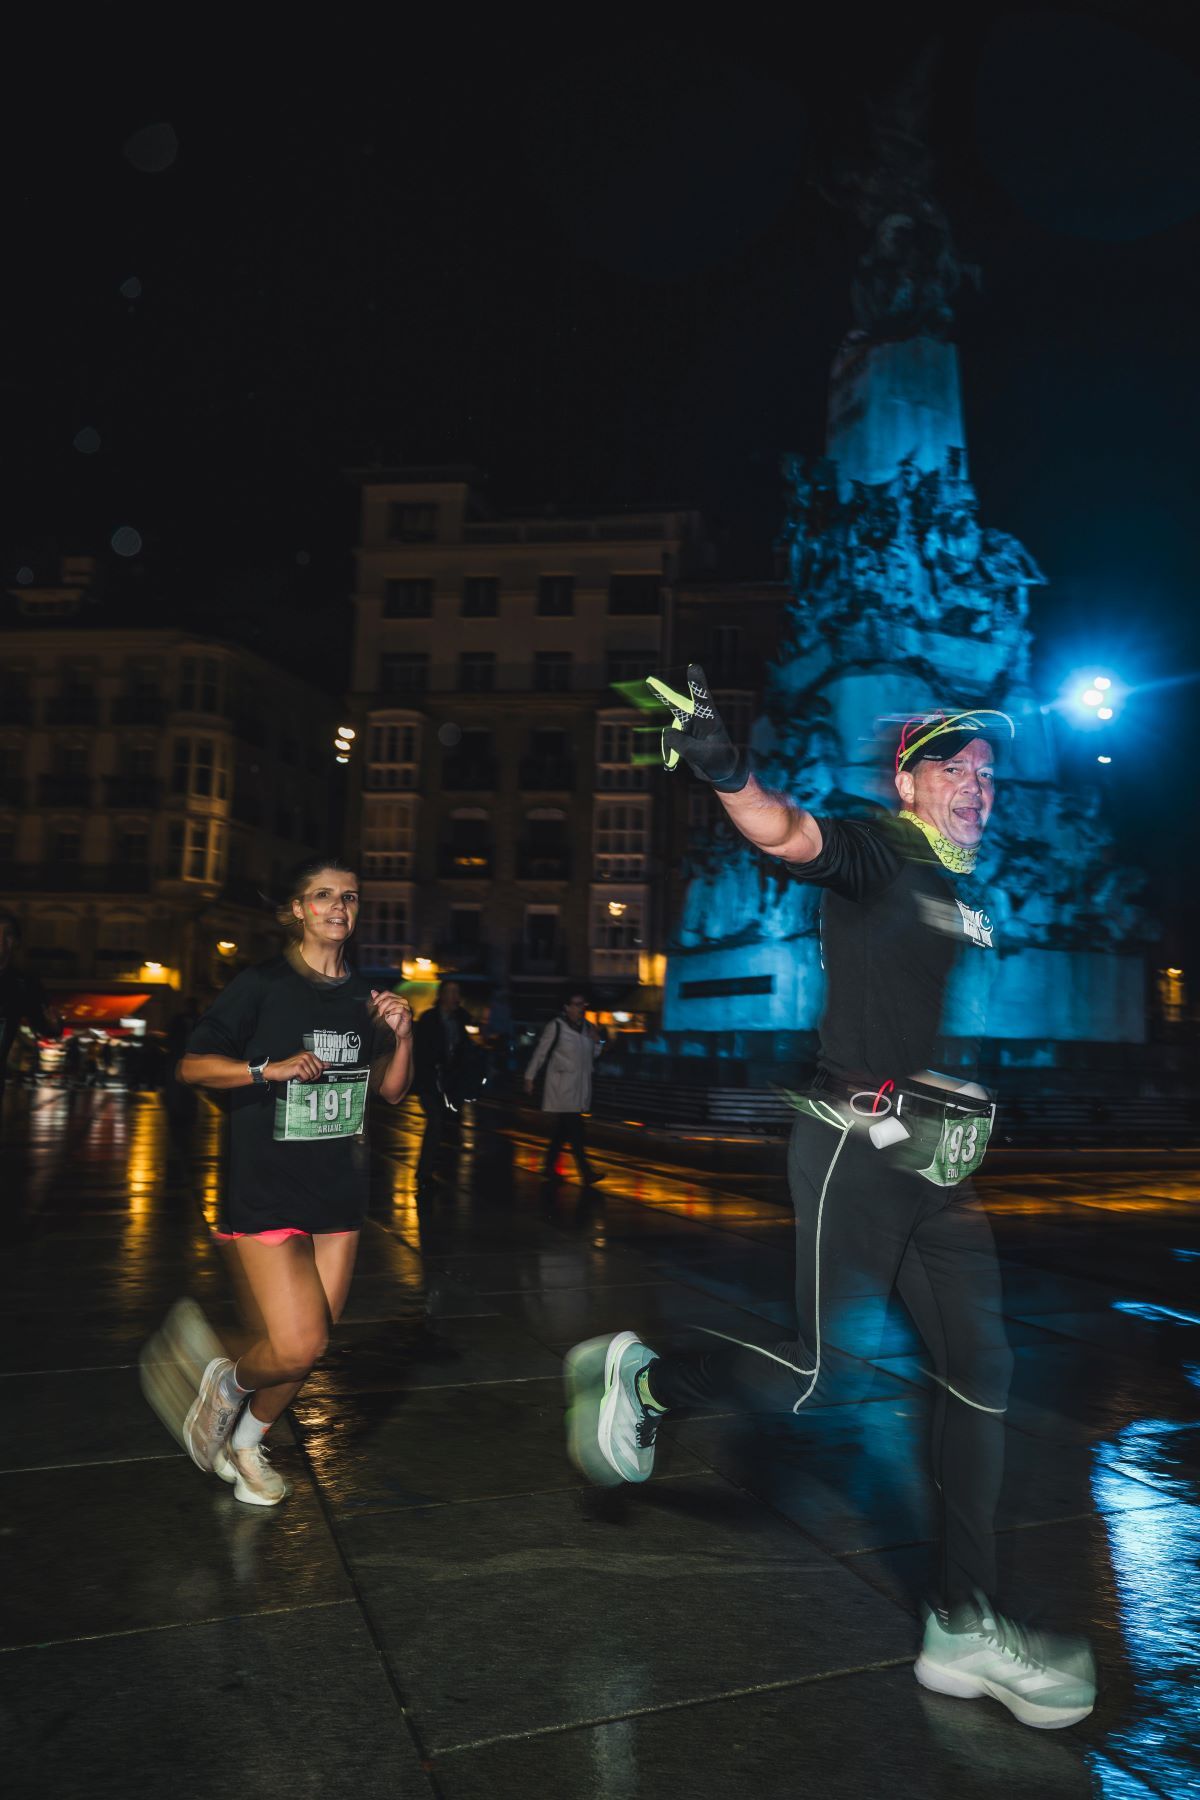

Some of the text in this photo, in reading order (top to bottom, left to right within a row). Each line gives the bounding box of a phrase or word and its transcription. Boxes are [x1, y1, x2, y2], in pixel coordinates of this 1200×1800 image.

[313, 1033, 348, 1048] VITORIA
[314, 1048, 359, 1062] NIGHT RUN
[305, 1088, 352, 1121] 191
[317, 1124, 343, 1134] ARIANE
